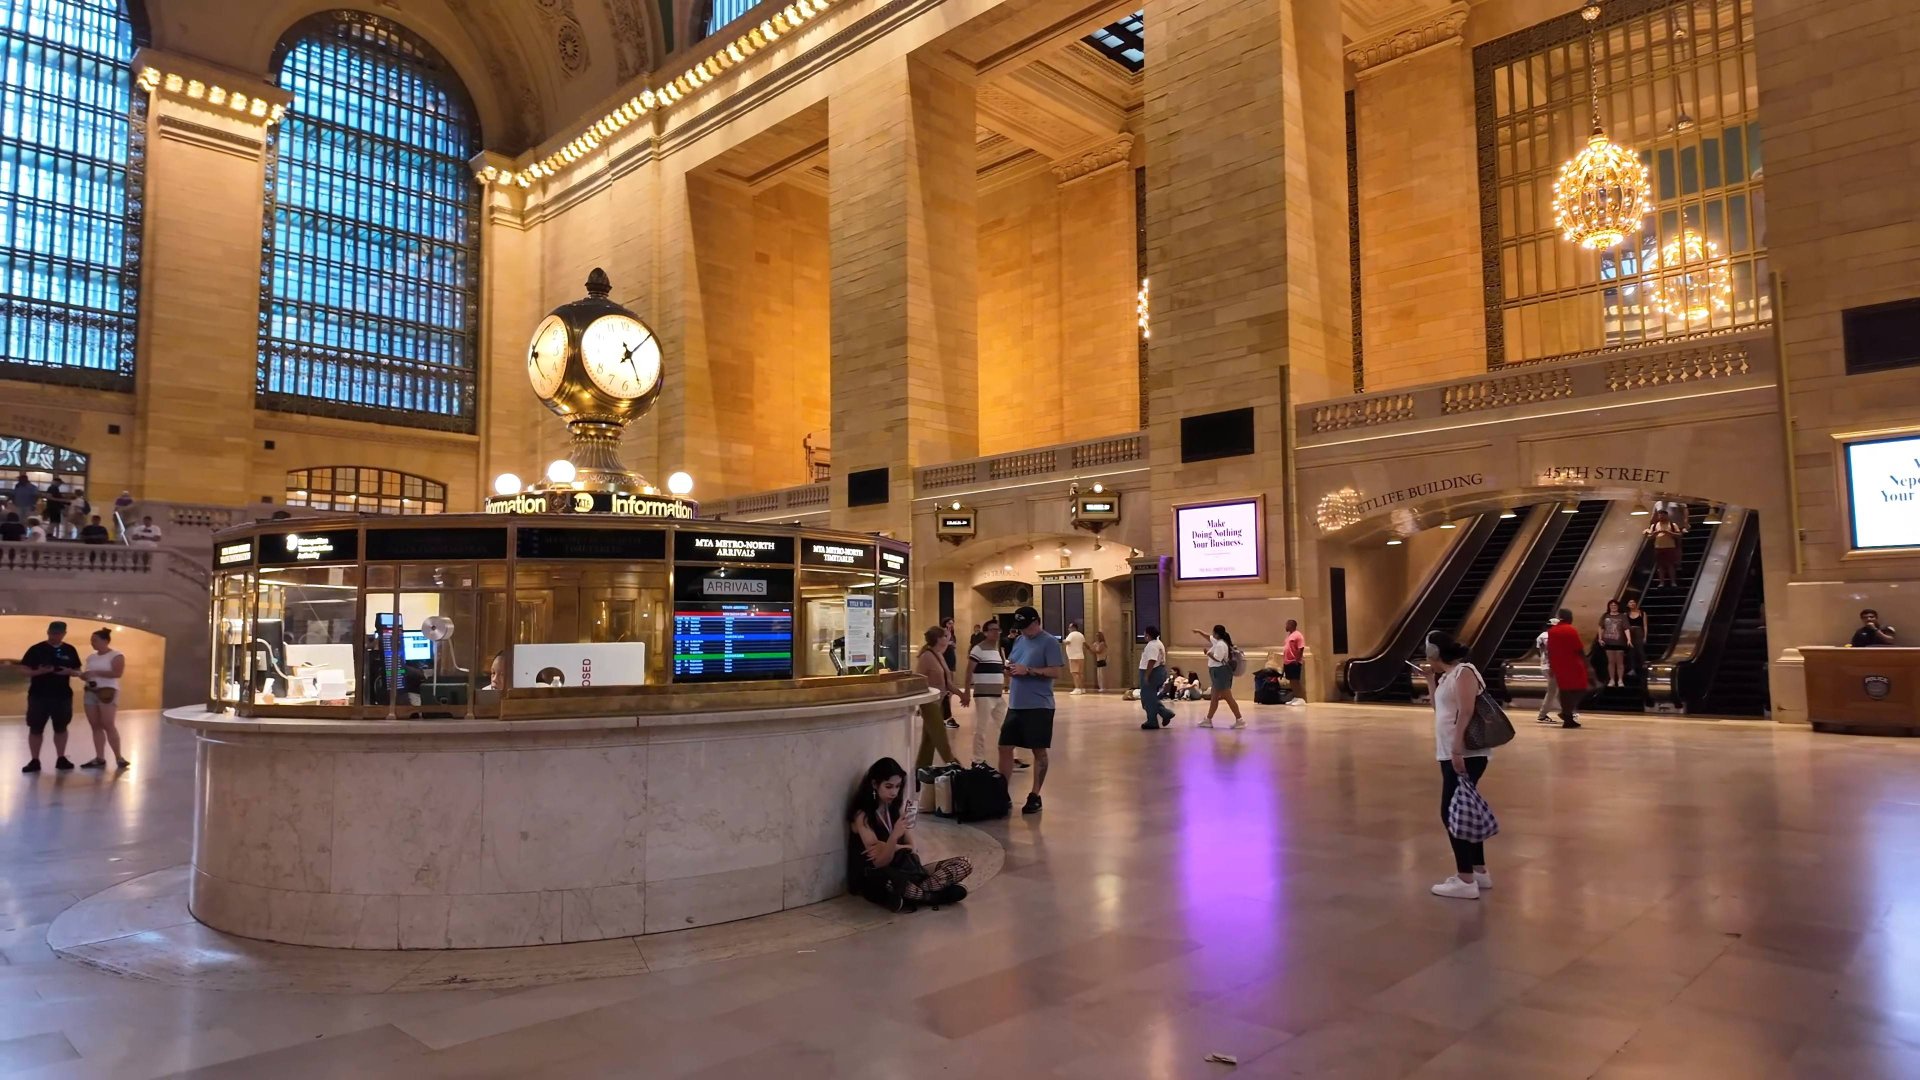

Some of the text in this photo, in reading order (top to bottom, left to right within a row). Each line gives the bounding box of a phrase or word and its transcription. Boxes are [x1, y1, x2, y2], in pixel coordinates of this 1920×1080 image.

[1542, 465, 1670, 485] 45TH STREET
[1356, 472, 1483, 514] ETLIFE BUILDING
[1880, 490, 1915, 503] Your
[611, 493, 693, 520] Information
[1206, 518, 1226, 528] Make
[1191, 528, 1243, 541] Doing Nothing
[695, 538, 775, 550] MTA METRO-NORTH
[1192, 538, 1244, 549] Your Business.
[716, 548, 756, 557] ARRIVALS
[706, 580, 765, 594] ARRIVALS
[1864, 675, 1889, 684] POLICE
